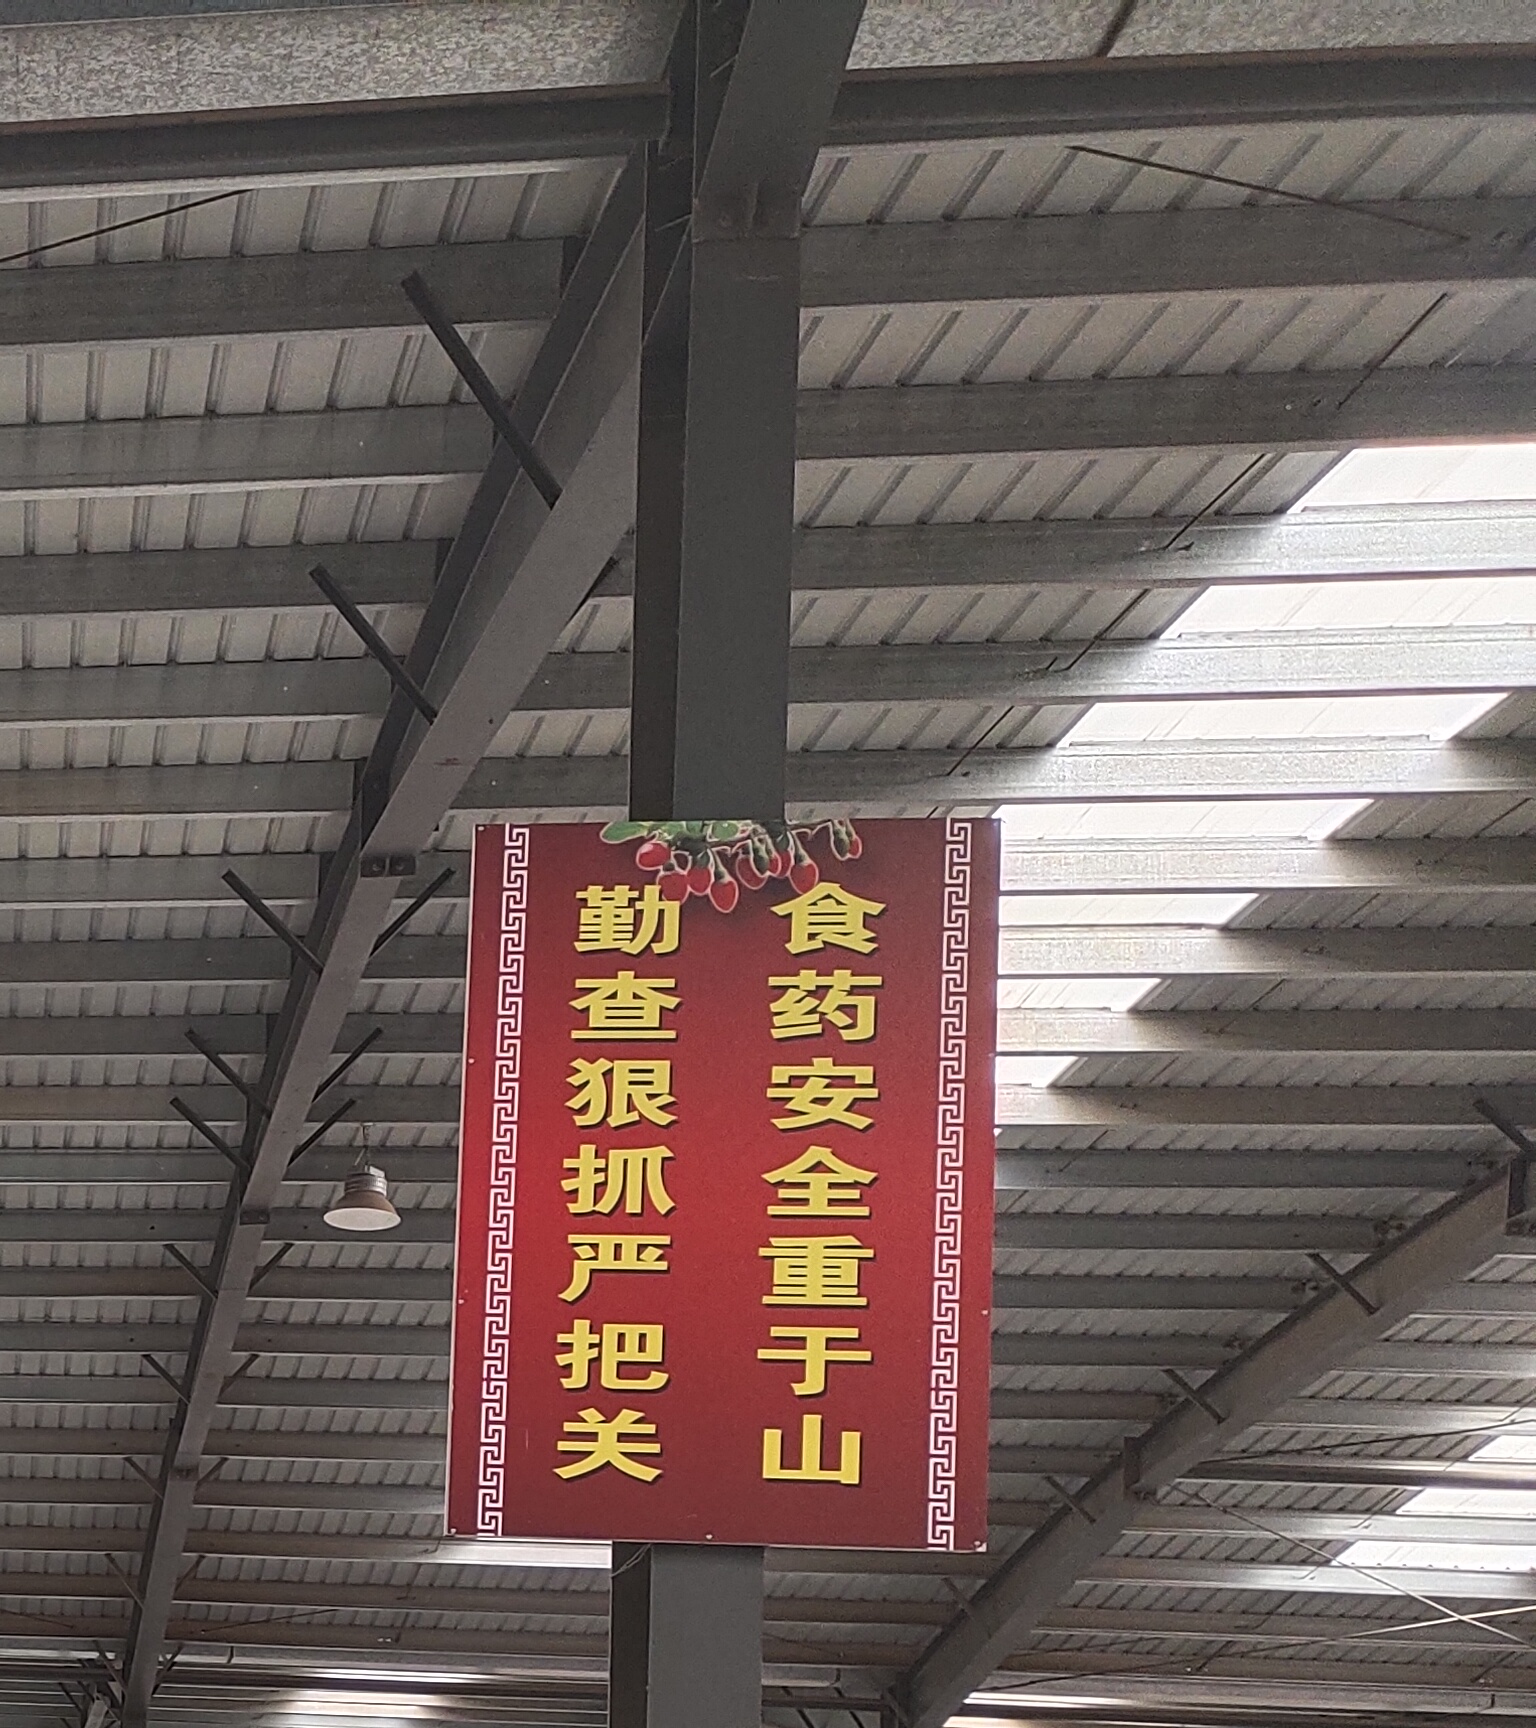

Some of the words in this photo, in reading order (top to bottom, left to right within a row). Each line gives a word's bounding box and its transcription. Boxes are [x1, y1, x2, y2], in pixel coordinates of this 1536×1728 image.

[553, 884, 682, 1484] 勤查狠抓严把关
[756, 883, 887, 1486] 食药安全重于山
